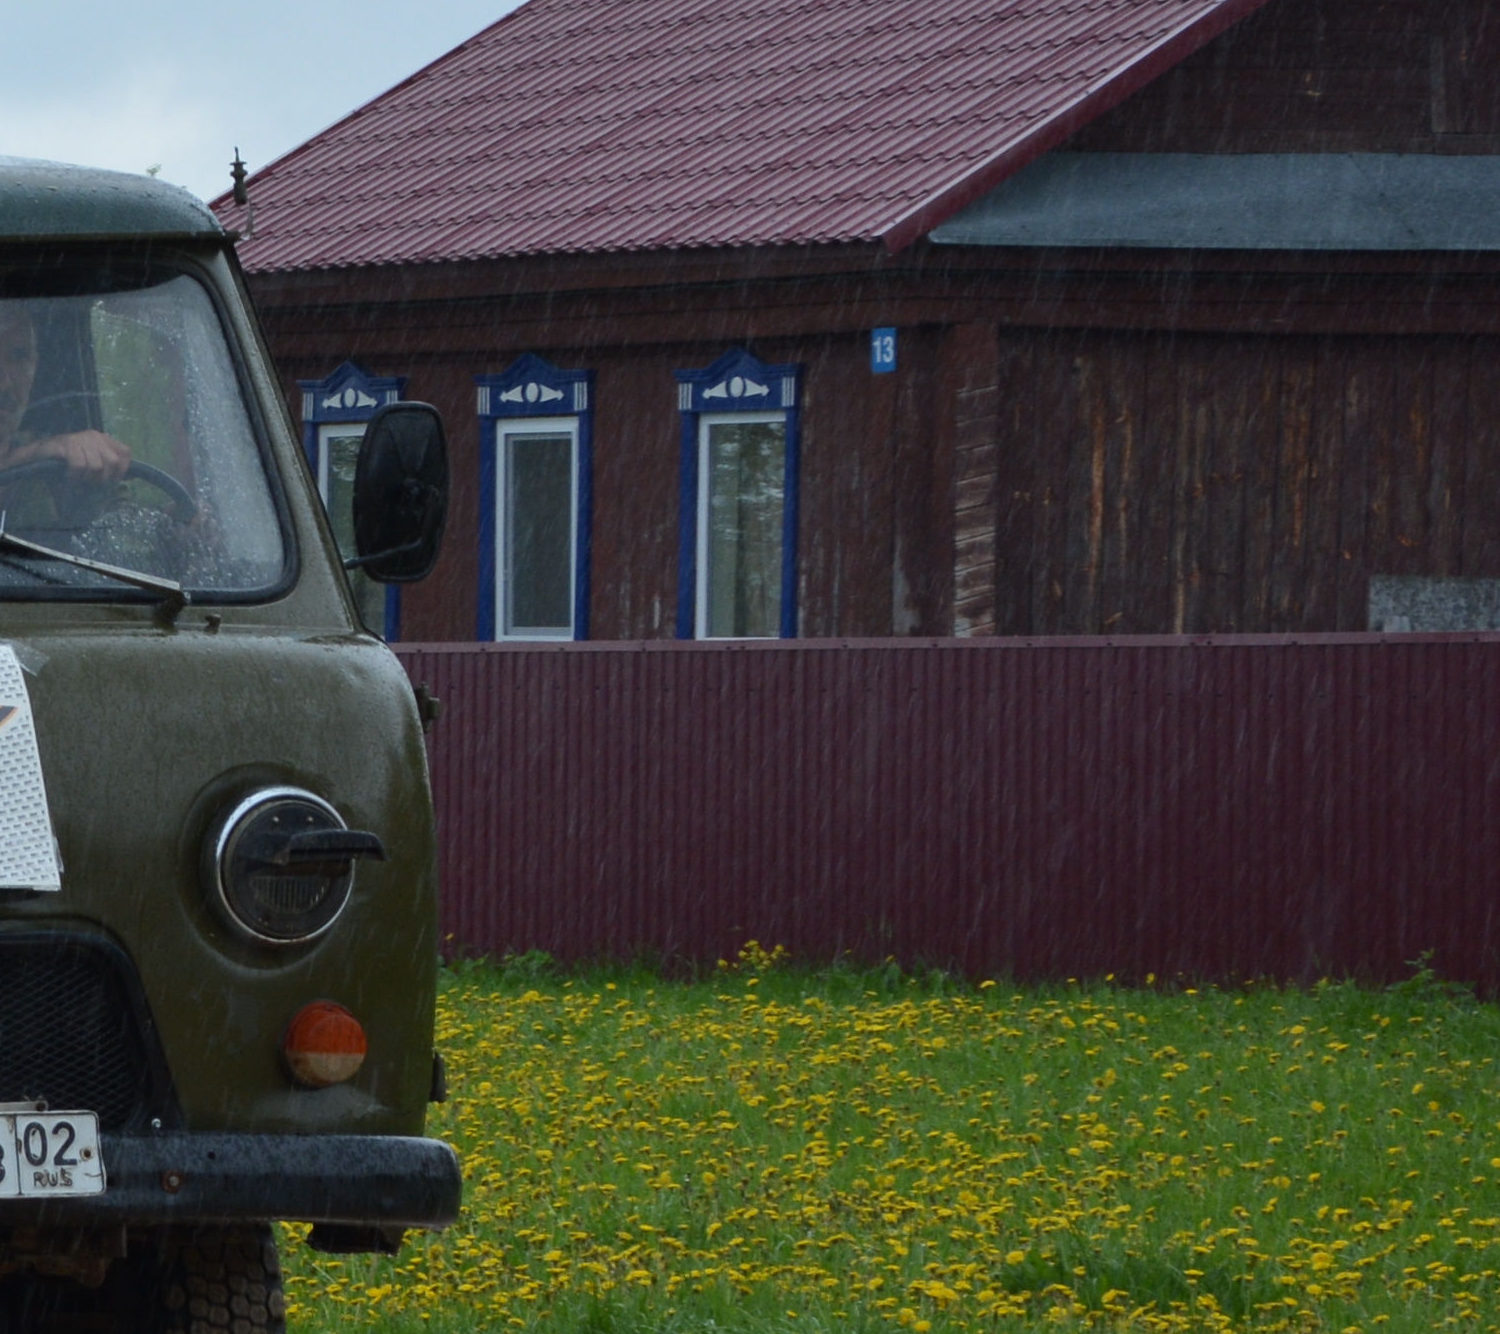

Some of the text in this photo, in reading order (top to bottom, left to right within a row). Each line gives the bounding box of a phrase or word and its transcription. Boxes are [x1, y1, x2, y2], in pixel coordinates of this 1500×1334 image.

[872, 336, 894, 363] 13
[23, 1121, 78, 1166] 02
[33, 1168, 73, 1188] RUS
